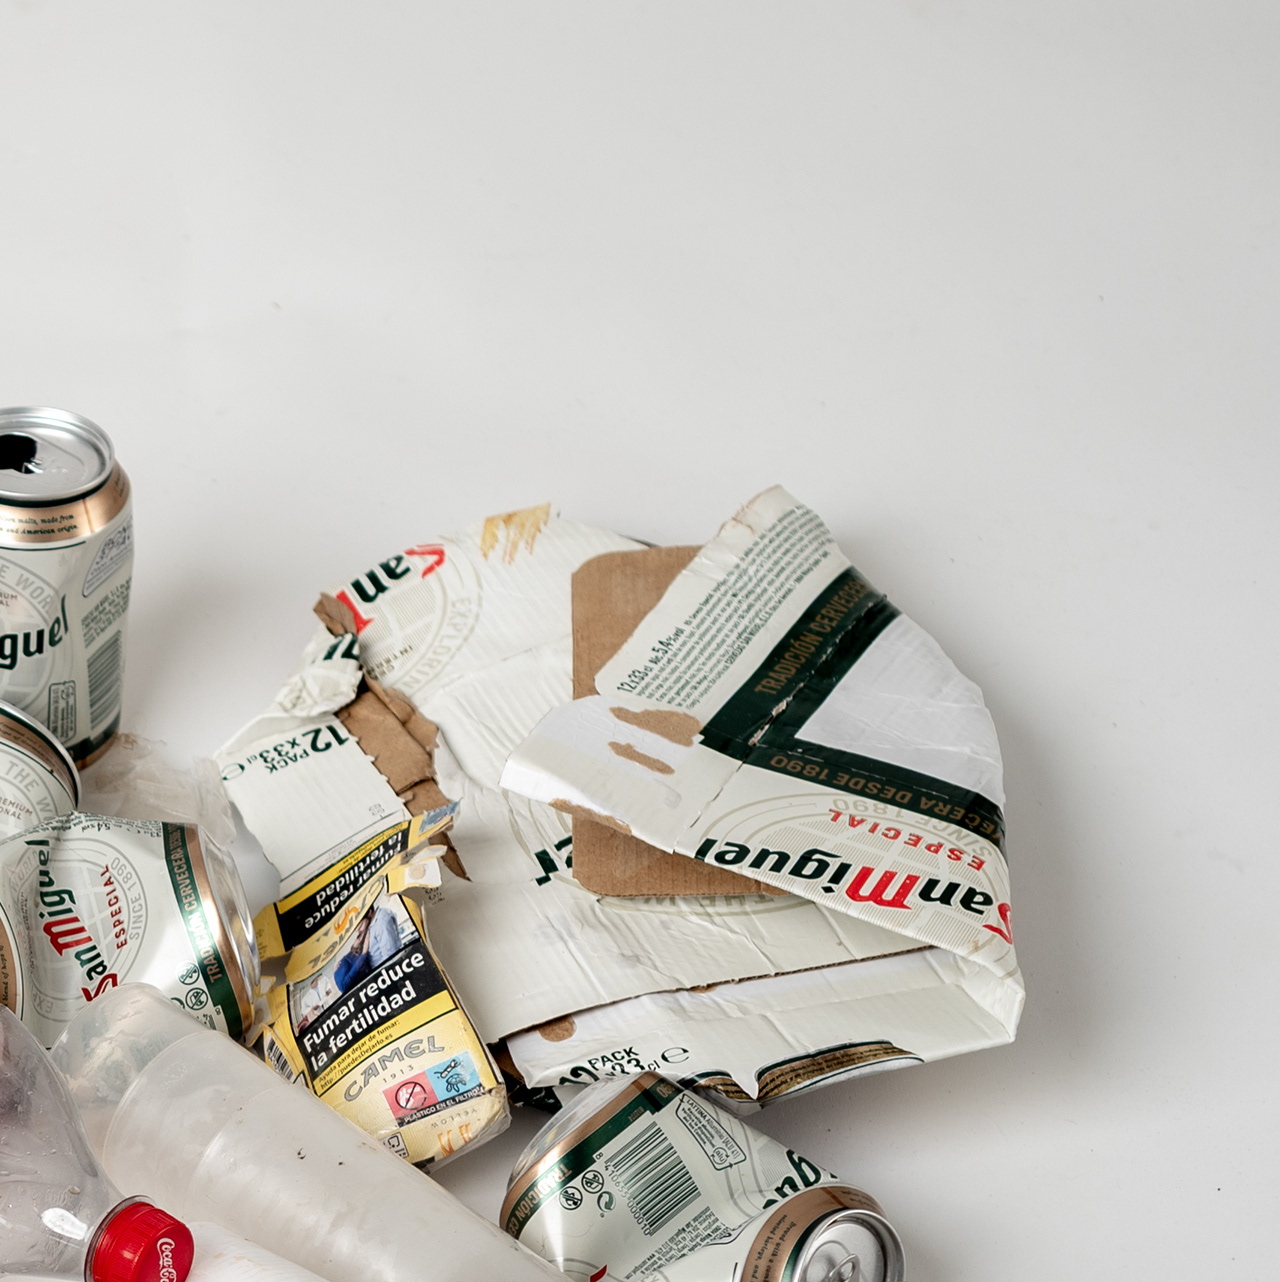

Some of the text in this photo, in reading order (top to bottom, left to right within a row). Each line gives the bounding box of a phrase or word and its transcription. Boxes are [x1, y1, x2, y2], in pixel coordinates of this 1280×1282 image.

[753, 630, 814, 697] TRADICIÓN
[2, 759, 42, 798] THE
[264, 723, 351, 775] 12 PACK
[770, 753, 912, 806] DESDE 1890
[827, 807, 989, 873] ESPECIAL
[102, 864, 128, 952] ESPECIAL
[164, 847, 224, 985] TRADICIÓN CERVECERA
[301, 949, 426, 1054] Fumar reduce
[310, 982, 419, 1073] la fertilidad
[343, 1033, 446, 1103] CAMEL
[381, 1063, 416, 1085] 1913
[587, 1045, 640, 1073] PACK
[403, 1103, 437, 1125] PLÁSTICO
